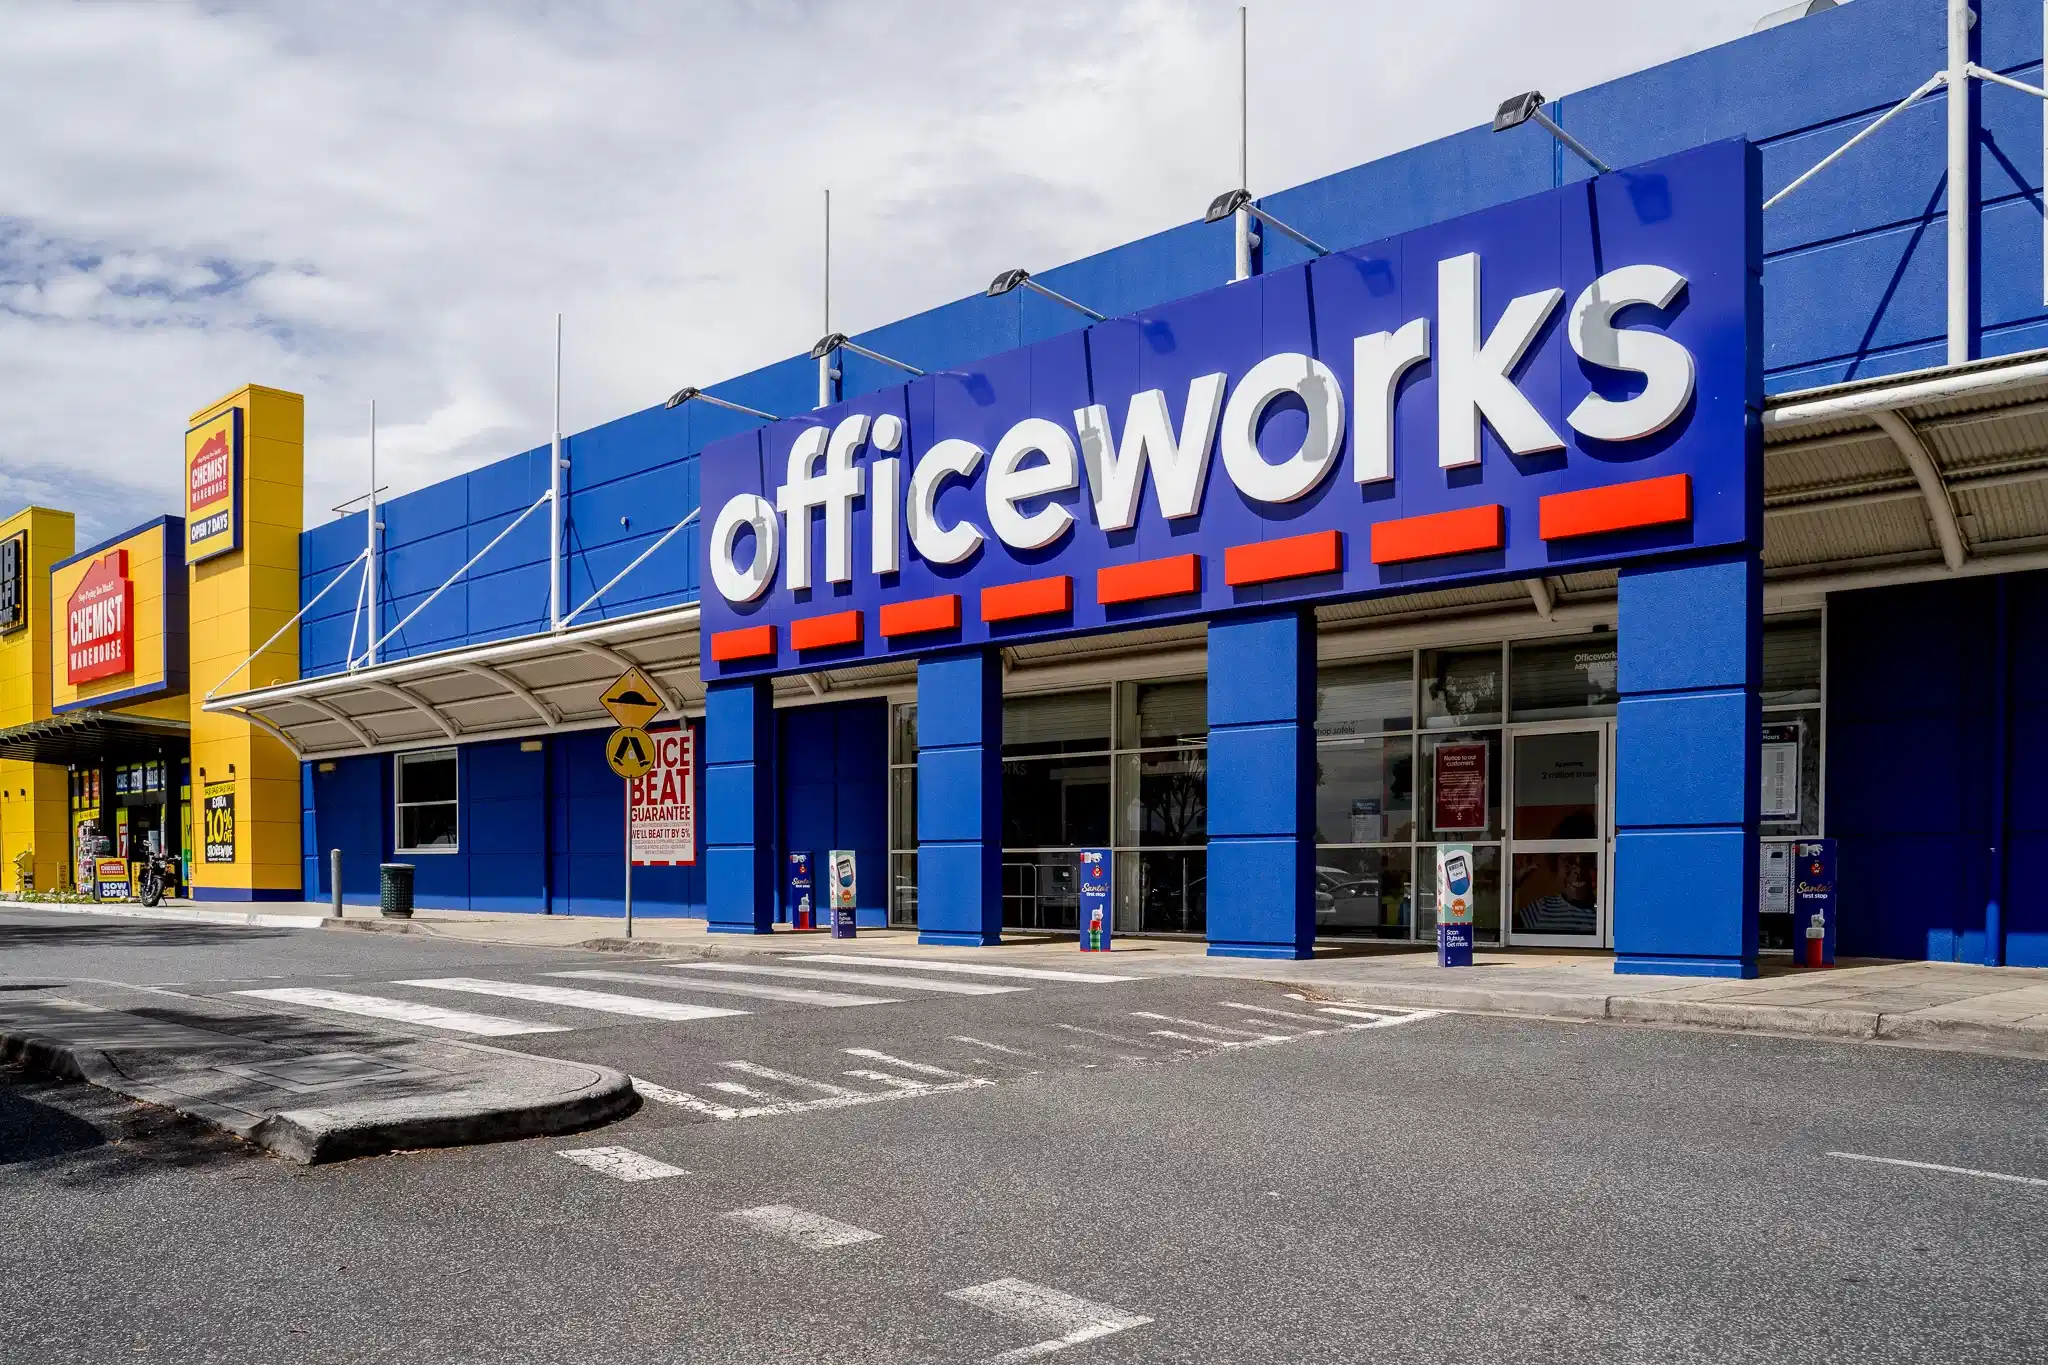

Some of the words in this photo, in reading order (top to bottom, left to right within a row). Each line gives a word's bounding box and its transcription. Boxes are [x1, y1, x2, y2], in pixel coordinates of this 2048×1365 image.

[709, 251, 1697, 603] officeworks
[192, 454, 228, 490] CHEMIST
[192, 480, 227, 503] WAREHOUSE
[191, 521, 207, 541] OPEN
[207, 520, 212, 535] 7
[212, 513, 228, 533] DAYS
[71, 594, 123, 647] CHEMIST
[71, 639, 122, 670] WAREHOUSE
[1574, 651, 1617, 662] Officework
[652, 736, 691, 769] ICE
[631, 768, 690, 806] BEAT
[631, 806, 691, 822] GUARANTEE
[648, 829, 663, 839] BEAT
[664, 829, 671, 839] IT
[671, 828, 680, 838] BY
[680, 828, 691, 838] 5%
[102, 882, 127, 890] NOW
[102, 889, 129, 897] OPEN
[1081, 882, 1110, 893] Santa's
[1796, 881, 1833, 895] Santa's
